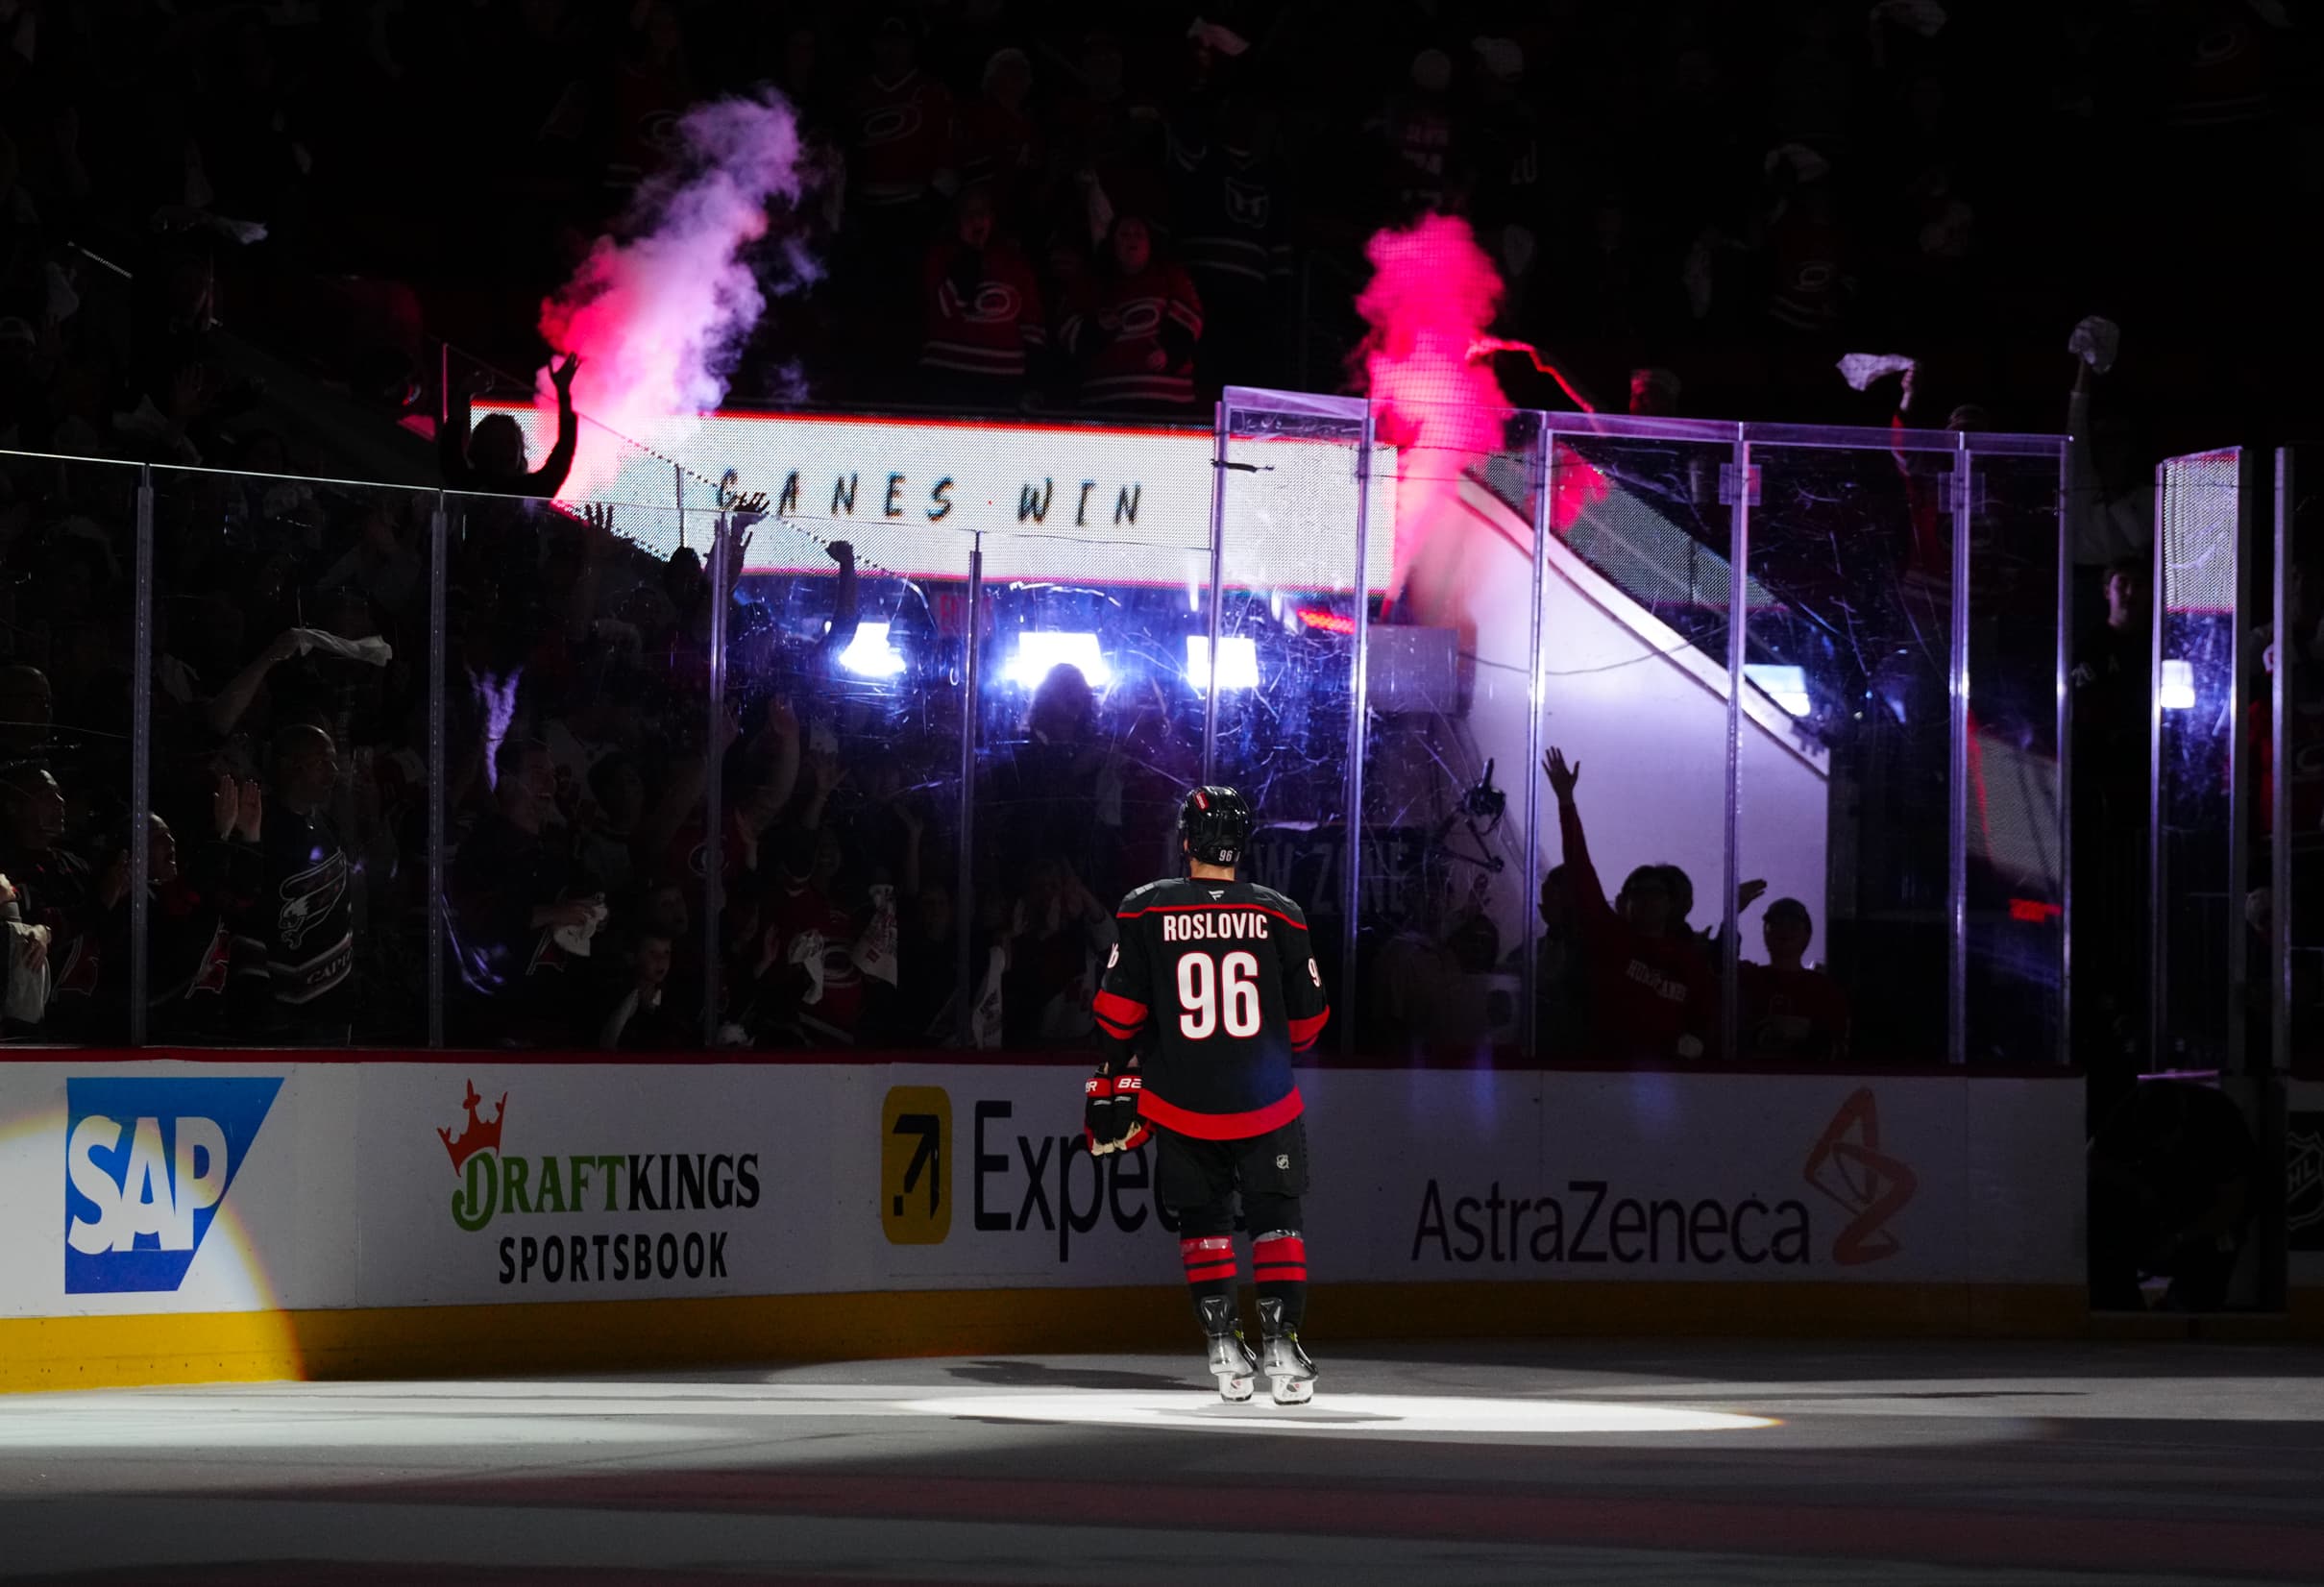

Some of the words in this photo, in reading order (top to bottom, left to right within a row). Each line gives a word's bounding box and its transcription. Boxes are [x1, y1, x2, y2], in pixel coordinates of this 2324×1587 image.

[717, 467, 954, 522] CANES
[1016, 477, 1141, 527] WIN
[1217, 848, 1234, 863] 96
[1162, 914, 1268, 941] ROSLOVIC
[1176, 950, 1261, 1040] 96
[67, 1115, 229, 1255] SAP
[452, 1152, 759, 1232] DRAFTKINGS
[1412, 1179, 1810, 1263] AstraZeneca
[499, 1232, 728, 1284] SPORTSBOOK
